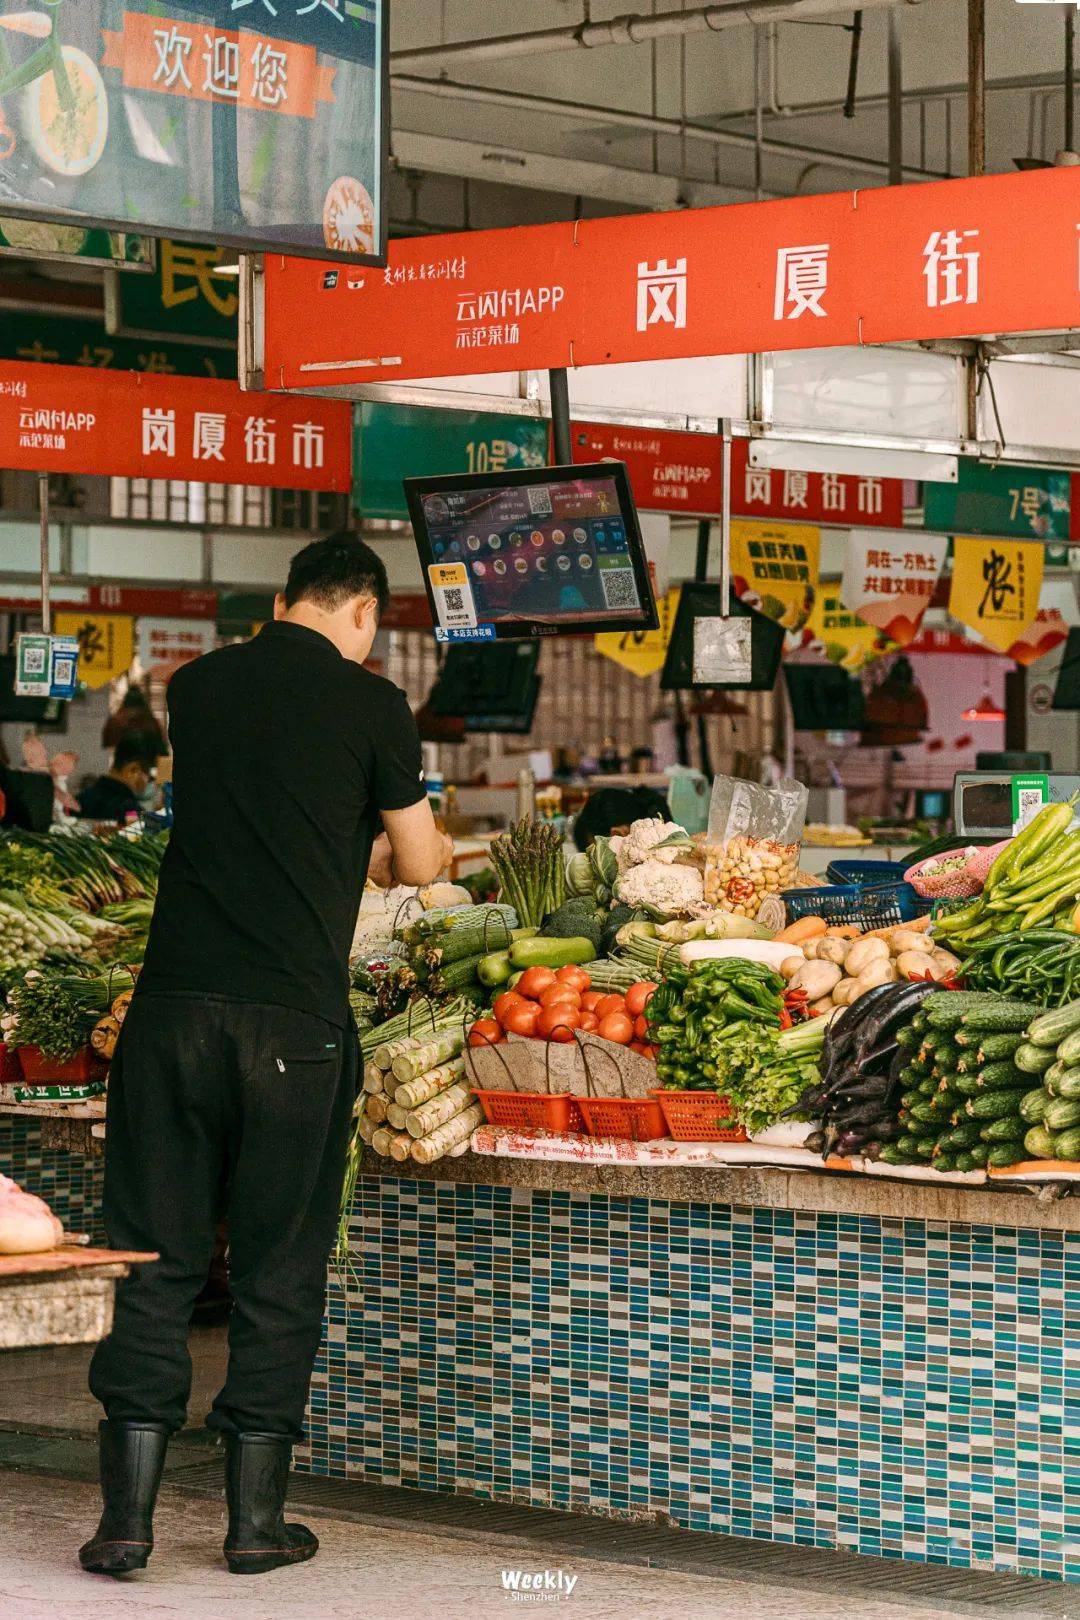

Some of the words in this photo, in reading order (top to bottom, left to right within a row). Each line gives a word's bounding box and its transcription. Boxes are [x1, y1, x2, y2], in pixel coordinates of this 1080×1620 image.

[152, 27, 289, 104] 欢迎您
[636, 222, 1080, 332] 岗厦街
[456, 286, 564, 321] 云闪付APP
[455, 323, 520, 348] 示范菜场
[19, 407, 95, 432] 云闪付APP
[142, 407, 325, 469] 岗厦街市
[1008, 486, 1041, 522] 7号
